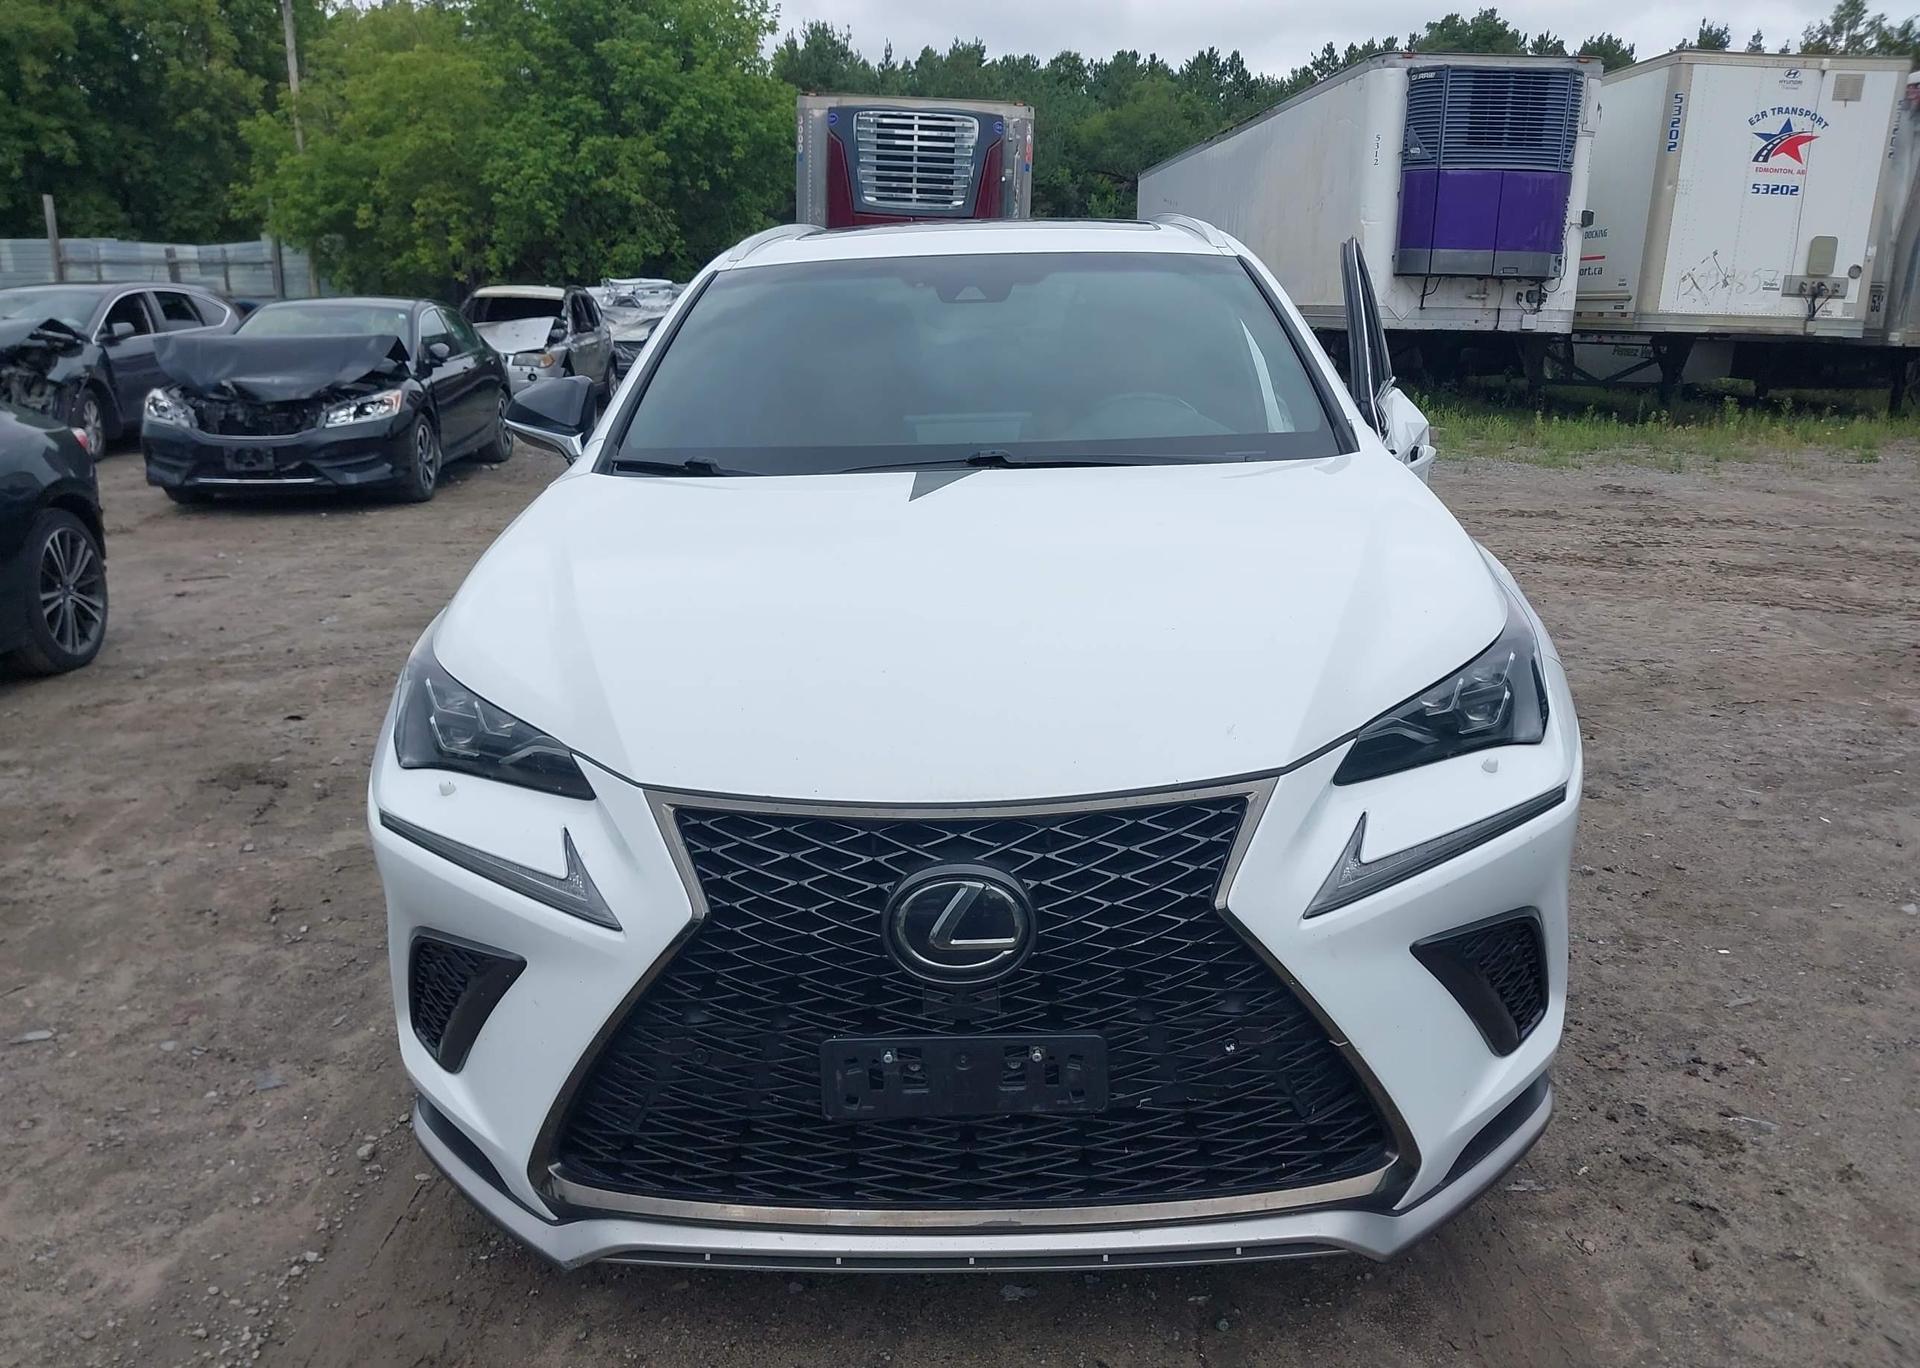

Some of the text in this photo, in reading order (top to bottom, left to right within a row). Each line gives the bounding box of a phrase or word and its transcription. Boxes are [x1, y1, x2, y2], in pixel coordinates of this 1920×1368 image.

[1667, 93, 1684, 152] 53202
[1748, 106, 1829, 130] E2R TRANSPORT
[1373, 134, 1381, 166] 5312
[1751, 183, 1800, 196] 53202
